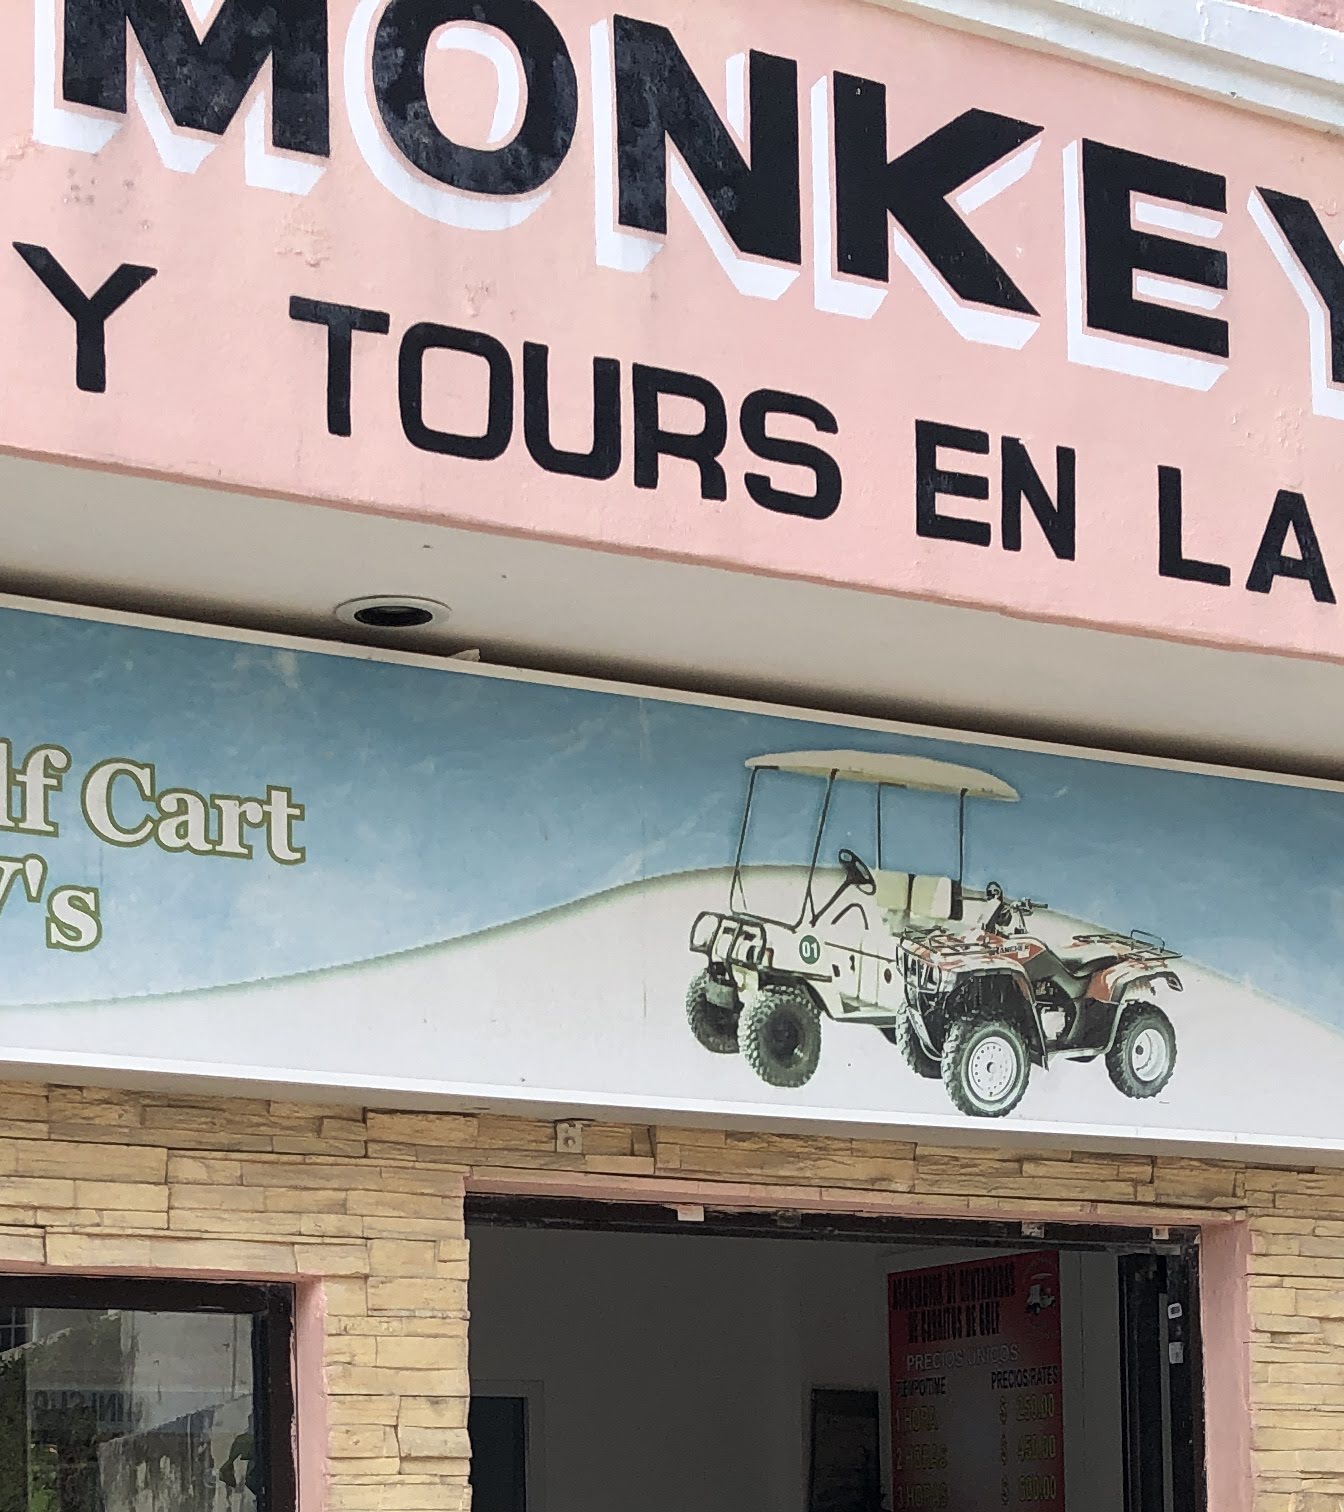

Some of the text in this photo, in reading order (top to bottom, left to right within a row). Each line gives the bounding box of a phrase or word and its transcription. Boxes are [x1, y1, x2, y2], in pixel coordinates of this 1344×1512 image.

[13, 241, 158, 393] Y
[289, 295, 843, 520] TOURS
[915, 419, 1076, 561] EN
[80, 757, 306, 866] Cart
[801, 942, 820, 960] 01
[906, 1351, 963, 1372] PRECIOS
